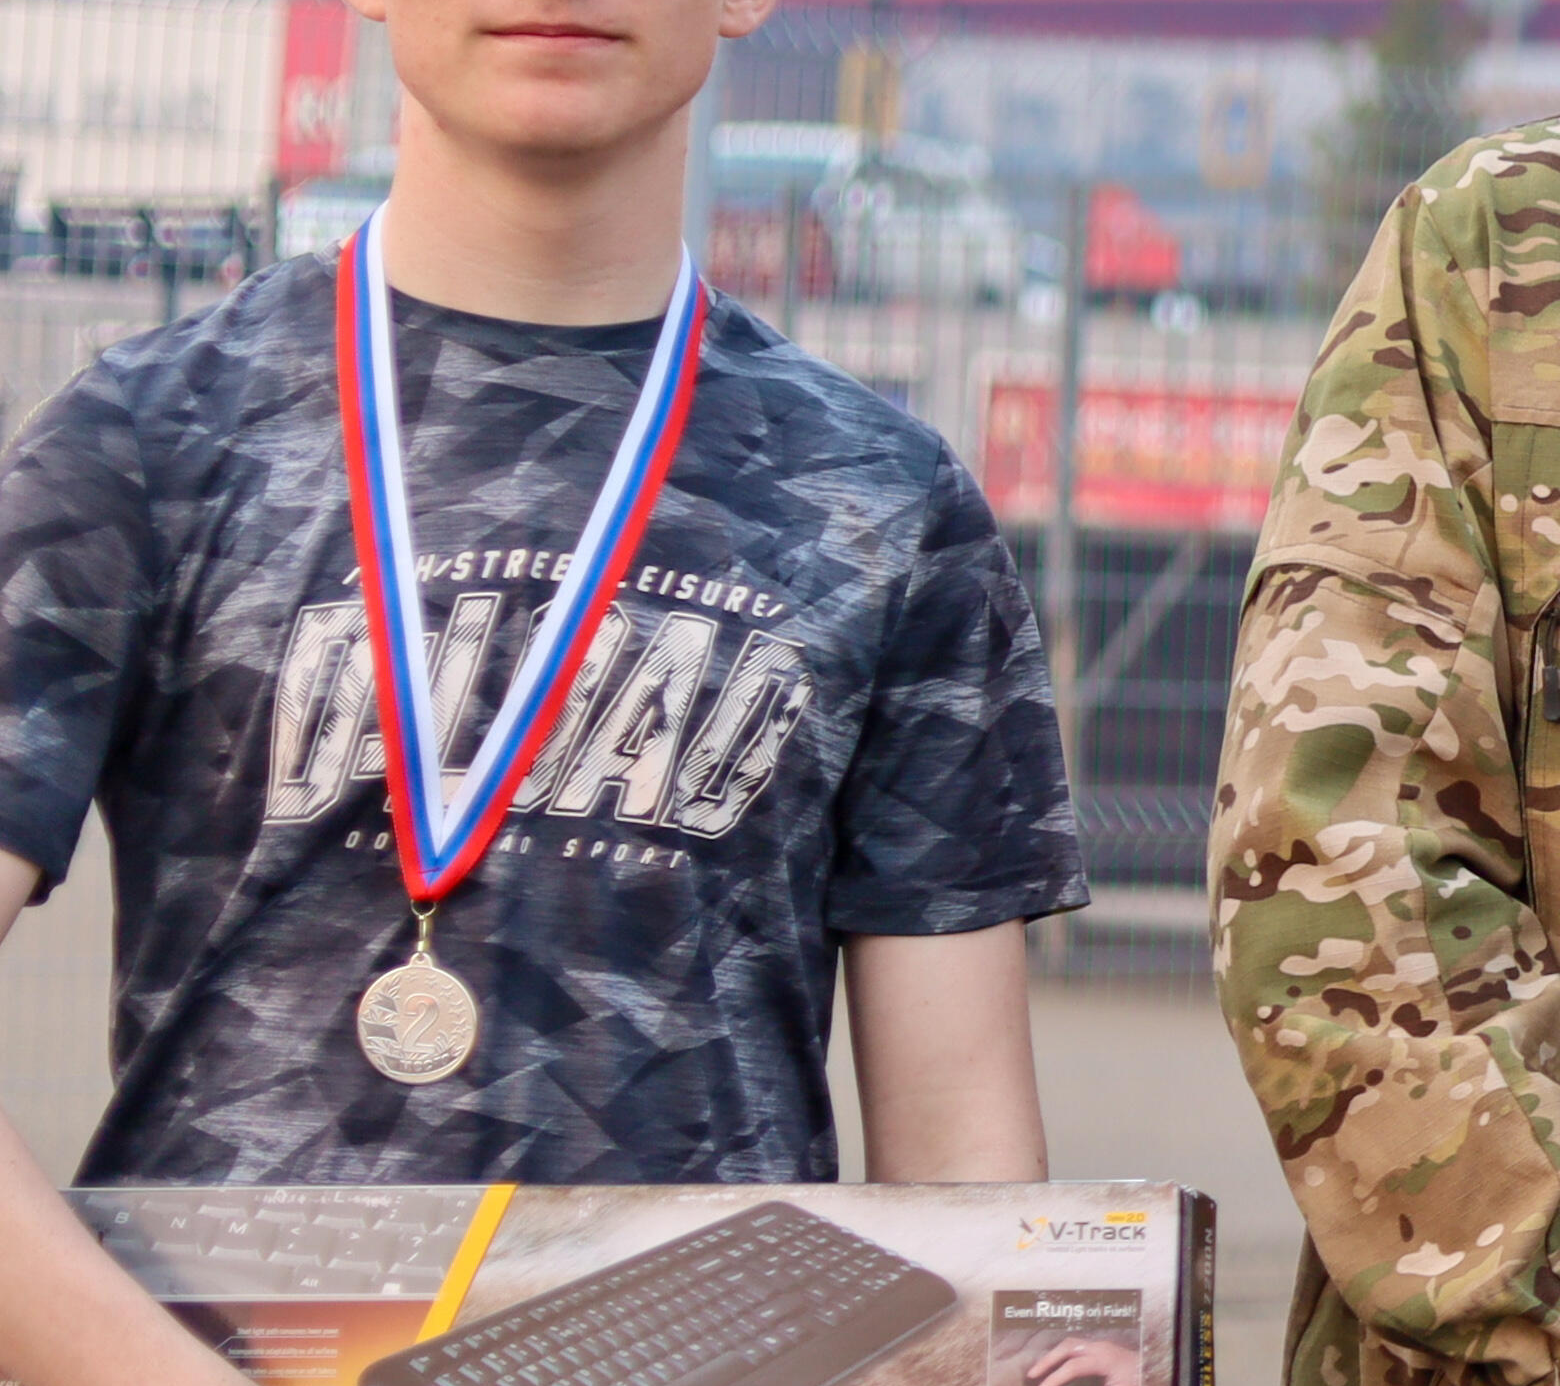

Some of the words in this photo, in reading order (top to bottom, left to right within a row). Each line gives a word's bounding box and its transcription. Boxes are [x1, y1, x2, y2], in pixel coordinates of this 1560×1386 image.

[1048, 1221, 1146, 1241] V-Track
[1004, 1305, 1034, 1319] Even
[1036, 1300, 1085, 1321] Runs
[1086, 1307, 1101, 1319] on
